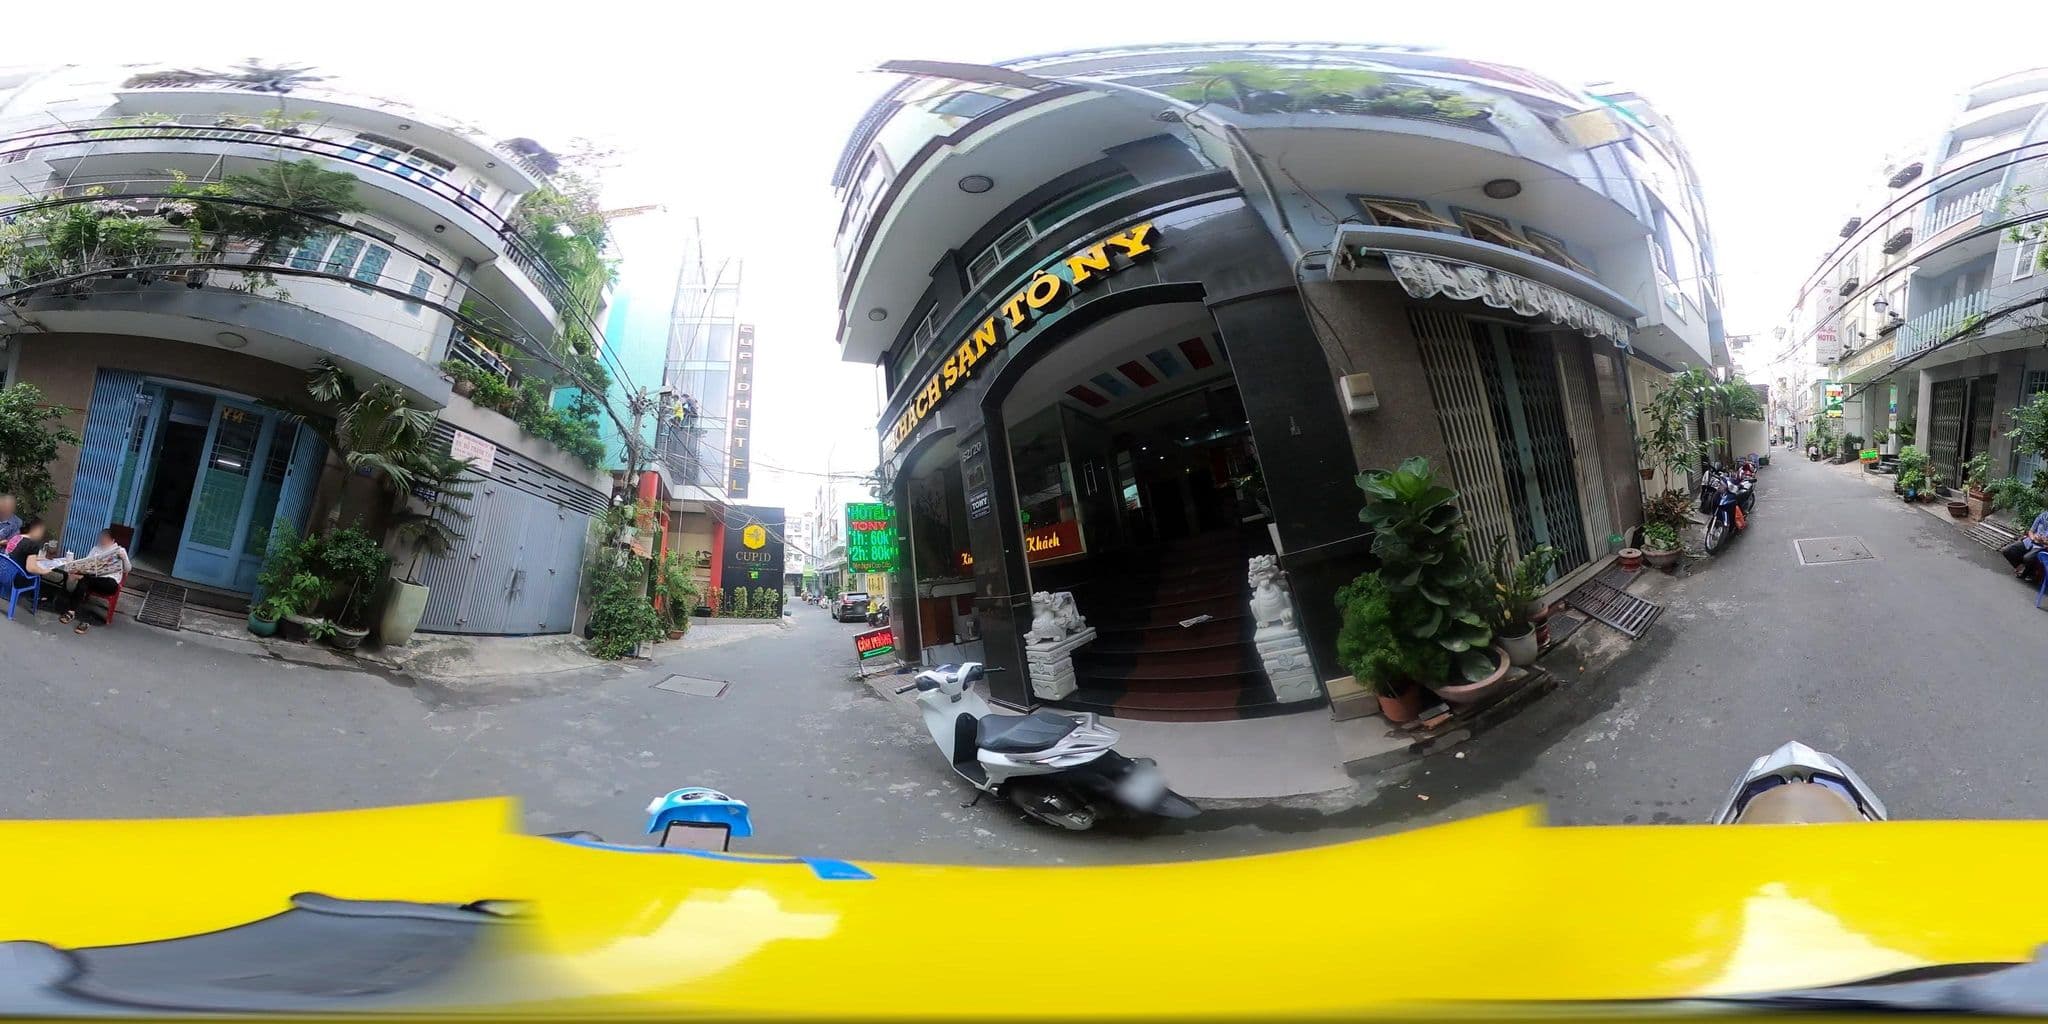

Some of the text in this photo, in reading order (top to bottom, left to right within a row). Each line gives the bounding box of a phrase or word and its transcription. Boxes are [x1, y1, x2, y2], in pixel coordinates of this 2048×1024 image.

[943, 316, 998, 390] SẠN
[971, 497, 988, 509] TONY
[852, 505, 889, 520] HOTEL
[851, 521, 887, 531] TONY
[1025, 531, 1061, 553] Khách
[735, 551, 772, 562] CUPID
